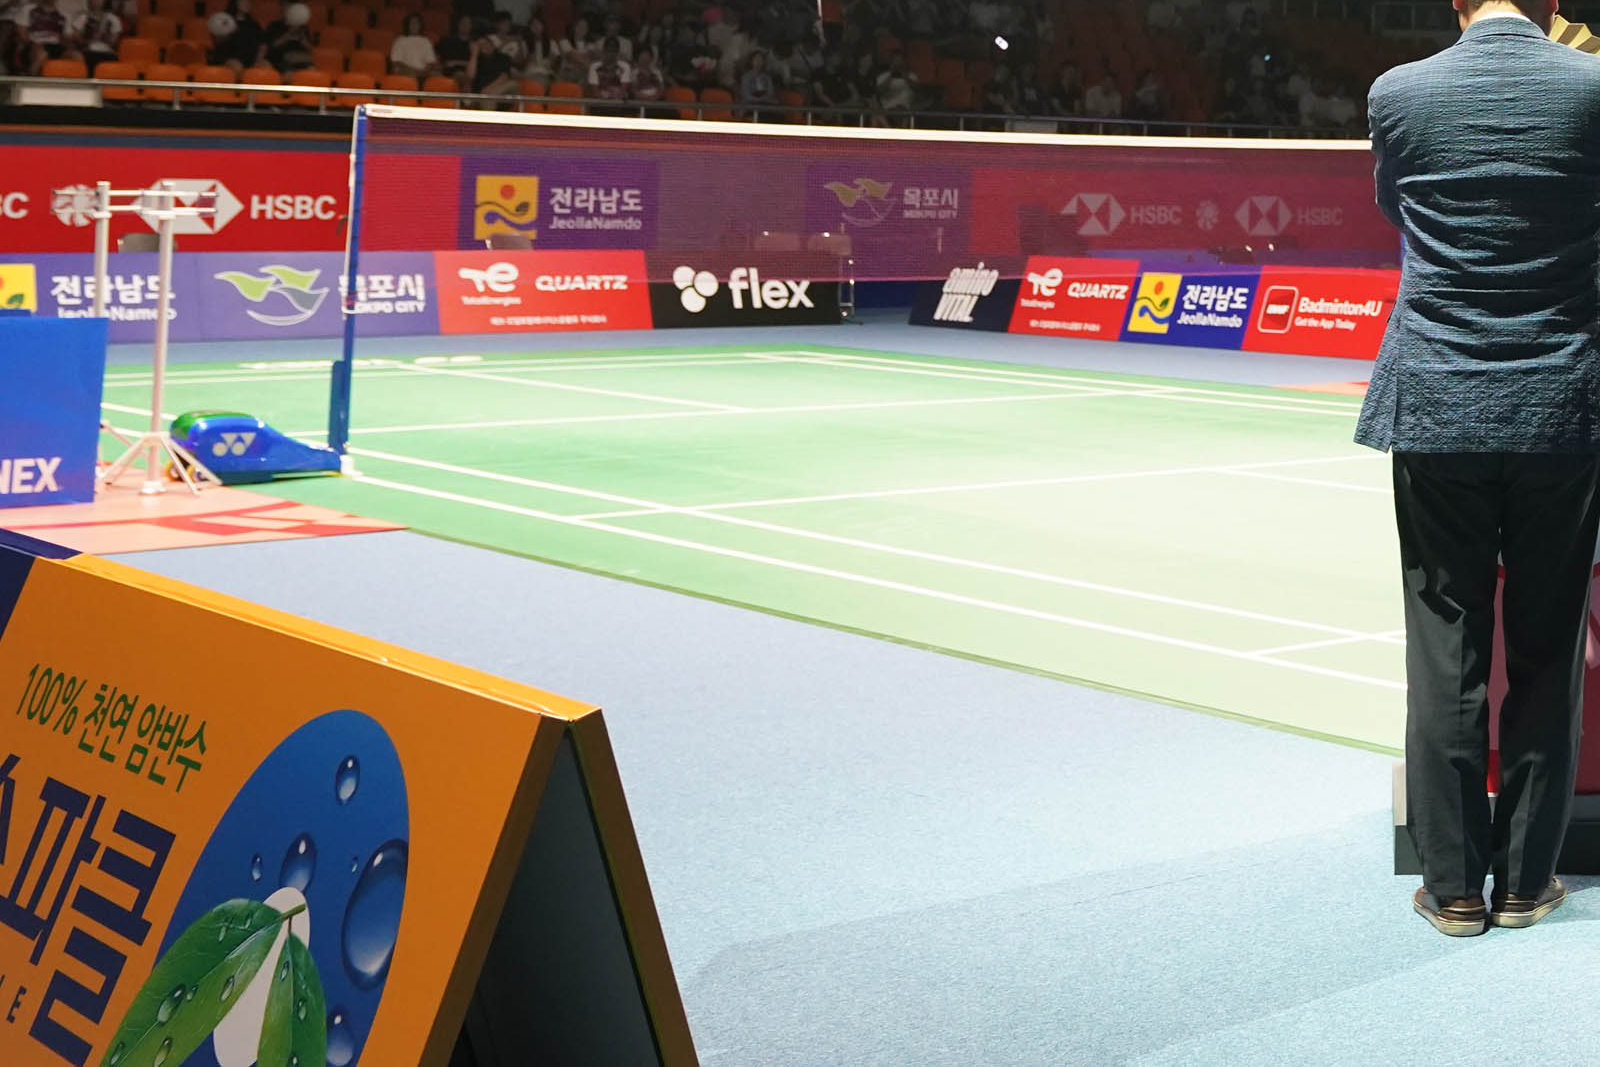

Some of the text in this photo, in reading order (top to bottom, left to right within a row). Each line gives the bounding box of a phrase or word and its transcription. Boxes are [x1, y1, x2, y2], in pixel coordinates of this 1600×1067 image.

[250, 195, 336, 221] HSBC
[549, 187, 643, 214] 전라남도
[1130, 205, 1182, 225] HSBC
[1297, 207, 1342, 226] HSBC
[535, 275, 629, 292] QUARTZ
[728, 267, 815, 309] flex
[1066, 282, 1129, 301] QUARTZ
[1182, 284, 1248, 312] 전라남도
[1298, 296, 1383, 317] Badminton4U
[16, 663, 207, 793] 100% 천연 암반수
